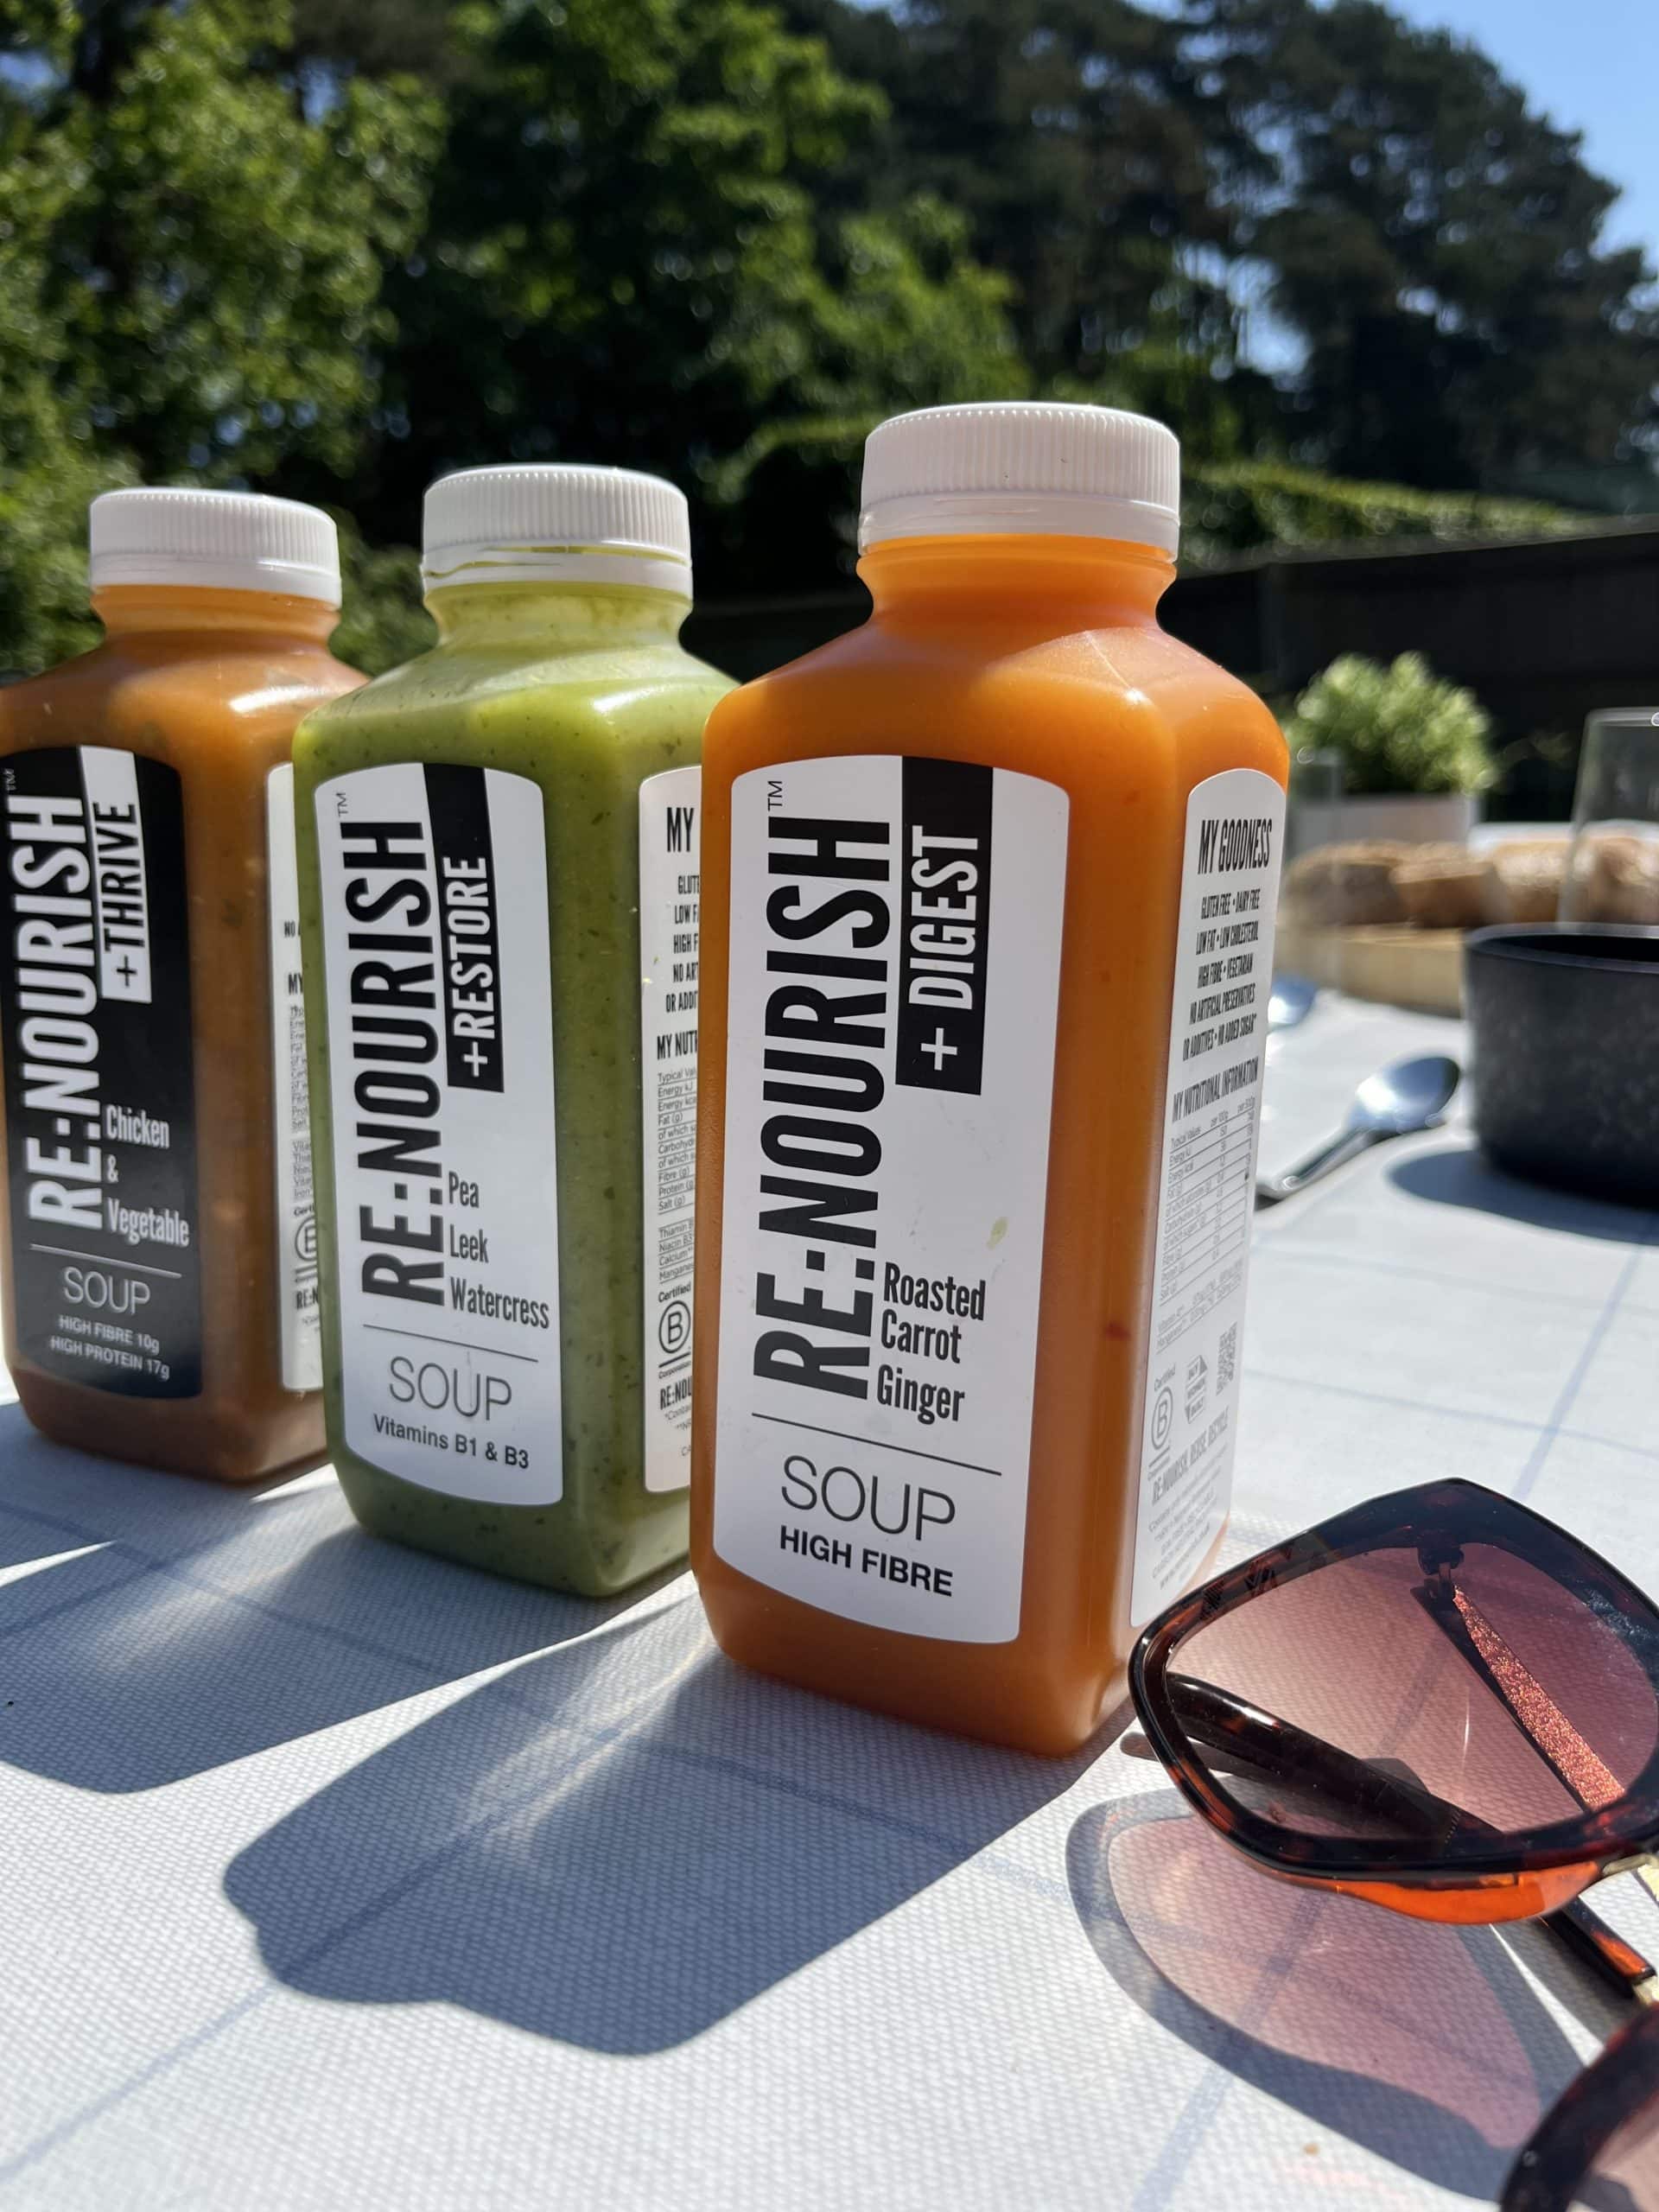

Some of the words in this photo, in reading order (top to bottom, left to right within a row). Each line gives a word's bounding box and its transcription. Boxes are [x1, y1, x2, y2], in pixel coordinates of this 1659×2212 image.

[666, 806, 695, 853] MY
[1197, 817, 1219, 875] MY
[1217, 817, 1273, 874] GOODNESS
[674, 904, 691, 925] LOW
[1200, 893, 1220, 920] GLUTEN
[1218, 892, 1231, 916] FREE
[1235, 890, 1250, 913] DAIRY
[1249, 887, 1261, 911] FREE
[673, 933, 692, 955] HIGH
[1195, 931, 1208, 956] LOW
[1207, 928, 1217, 953] FAT
[1219, 925, 1230, 950] LOW
[1230, 920, 1259, 947] CHOLESTEROL
[672, 963, 684, 983] NO
[1198, 963, 1210, 989] HIGH
[1209, 959, 1223, 985] FIBRE
[1226, 951, 1254, 981] VEGETARIAN
[7, 795, 102, 1230] RE:NOURISH
[665, 993, 677, 1014] OR
[1189, 1001, 1198, 1026] NO
[1196, 993, 1222, 1023] ARTIFICIAL
[1221, 982, 1256, 1014] PRESERVATIVES
[657, 1033, 672, 1061] MY
[1182, 1037, 1190, 1062] OR
[1189, 1027, 1215, 1058] ADDITIVES
[1217, 1023, 1225, 1046] NO
[340, 821, 445, 1307] RE:NOURISH
[658, 1069, 683, 1085] Typical
[658, 1084, 683, 1098] Energy
[658, 1099, 683, 1113] Energy
[753, 816, 891, 1401] RE:NOURISH
[1172, 1090, 1184, 1123] MY
[1183, 1072, 1221, 1119] NUTRITIONAL
[1220, 1056, 1259, 1098] INFORMATION
[105, 1103, 170, 1149] Chicken
[658, 1113, 671, 1127] Fat
[106, 1154, 119, 1183] &
[658, 1170, 678, 1183] Fibre
[448, 1171, 480, 1209] Pea
[658, 1181, 684, 1197] Protein
[658, 1198, 673, 1211] Salt
[107, 1198, 190, 1248] Vegetable
[448, 1224, 490, 1263] Leek
[62, 1265, 151, 1315] SOUP
[450, 1276, 550, 1329] Watercress
[658, 1281, 692, 1303] Certified
[882, 1261, 987, 1321] Roasted
[59, 1314, 92, 1338] HIGH
[93, 1322, 134, 1347] FIBRE
[137, 1333, 160, 1355] 10g
[880, 1307, 963, 1364] Carrot
[49, 1336, 84, 1358] HIGH
[86, 1344, 144, 1371] PROTEIN
[146, 1358, 170, 1382] 17g
[390, 1356, 513, 1421] SOUP
[876, 1363, 966, 1426] Ginger
[372, 1413, 450, 1452] Vitamins
[454, 1434, 477, 1457] B1
[485, 1441, 499, 1462] &
[505, 1446, 530, 1470] B3
[781, 1454, 957, 1542] SOUP
[779, 1524, 853, 1569] HIGH
[861, 1548, 954, 1598] FIBRE
